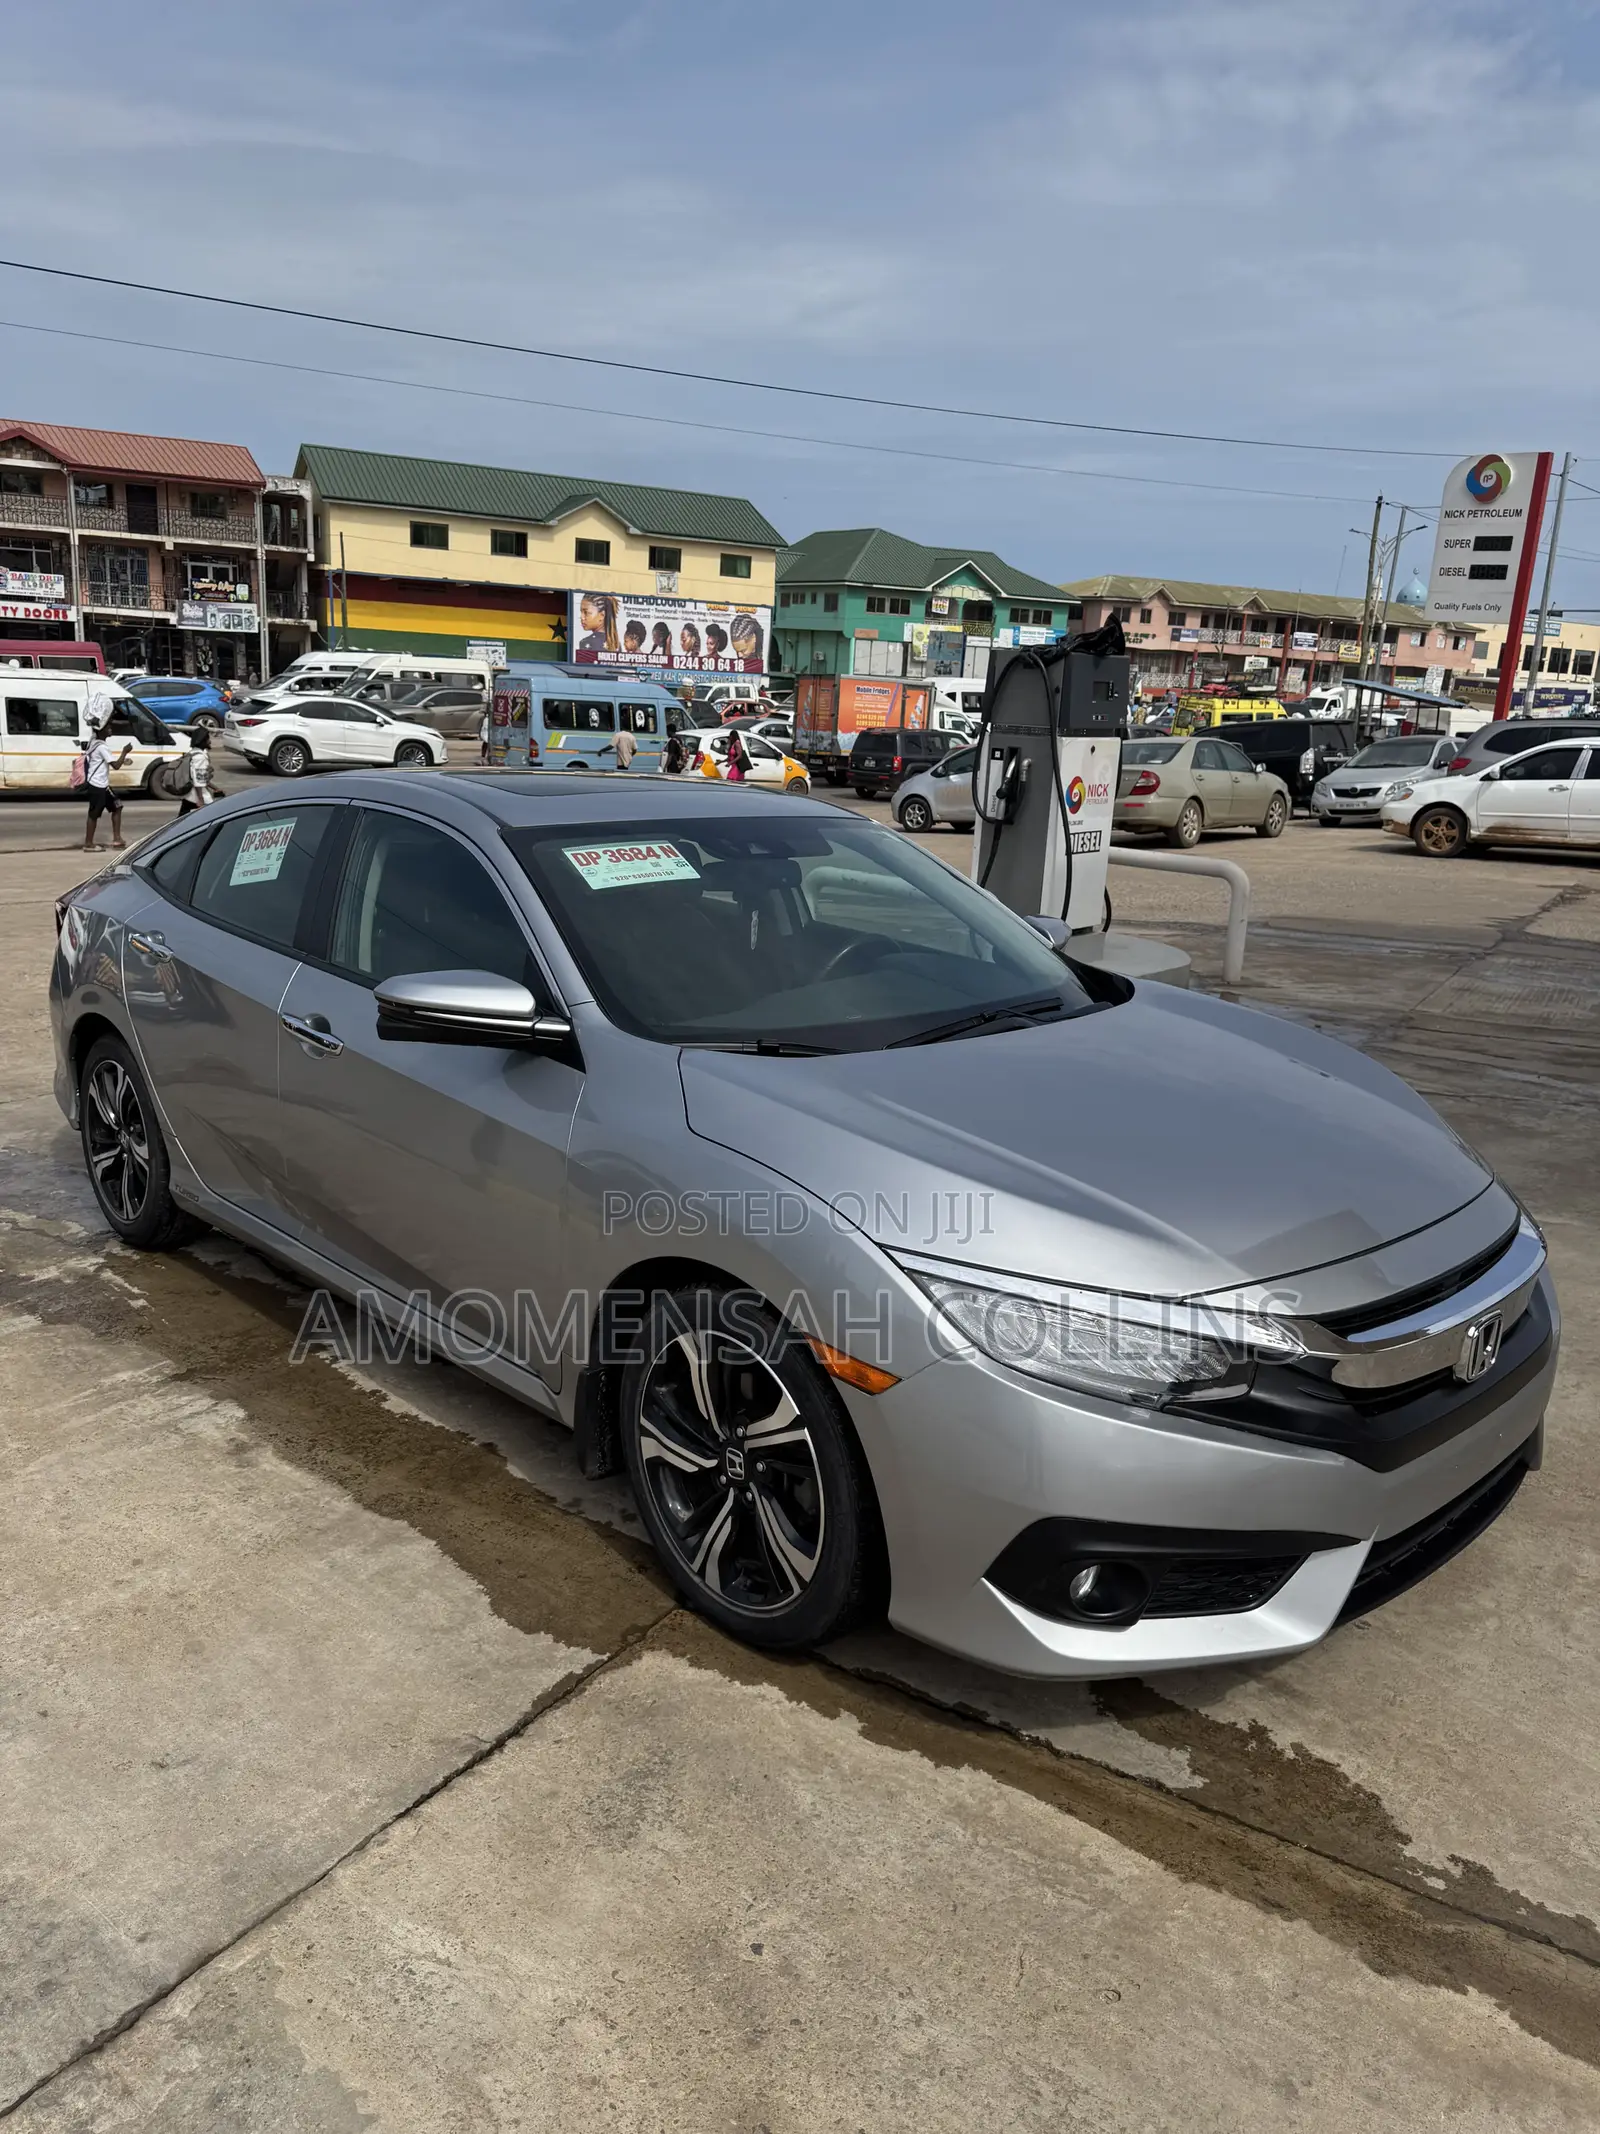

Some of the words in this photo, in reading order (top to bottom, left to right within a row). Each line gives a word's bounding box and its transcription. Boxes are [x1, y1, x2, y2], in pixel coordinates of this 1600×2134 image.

[1444, 509, 1465, 518] NICK
[1467, 508, 1523, 518] PETROLEUM
[1443, 538, 1472, 549] SUPER
[1439, 566, 1467, 577] DIESEL
[24, 607, 69, 620] DOORS
[1434, 602, 1460, 612] Quality
[1462, 602, 1482, 611] Fuels
[1484, 603, 1502, 613] Only
[597, 651, 617, 662] MULTI
[618, 652, 647, 663] CLIPPERS
[648, 655, 669, 664] SALON
[673, 656, 700, 670] 0244
[702, 657, 715, 671] 30
[717, 658, 731, 672] 64
[733, 659, 745, 672] 18
[872, 687, 890, 695] Fridges
[1087, 783, 1110, 798] NICK
[240, 832, 258, 853] DP
[254, 827, 283, 851] 3684
[280, 825, 293, 847] N
[570, 851, 602, 867] DP
[602, 845, 661, 864] 3684
[658, 845, 680, 859] N
